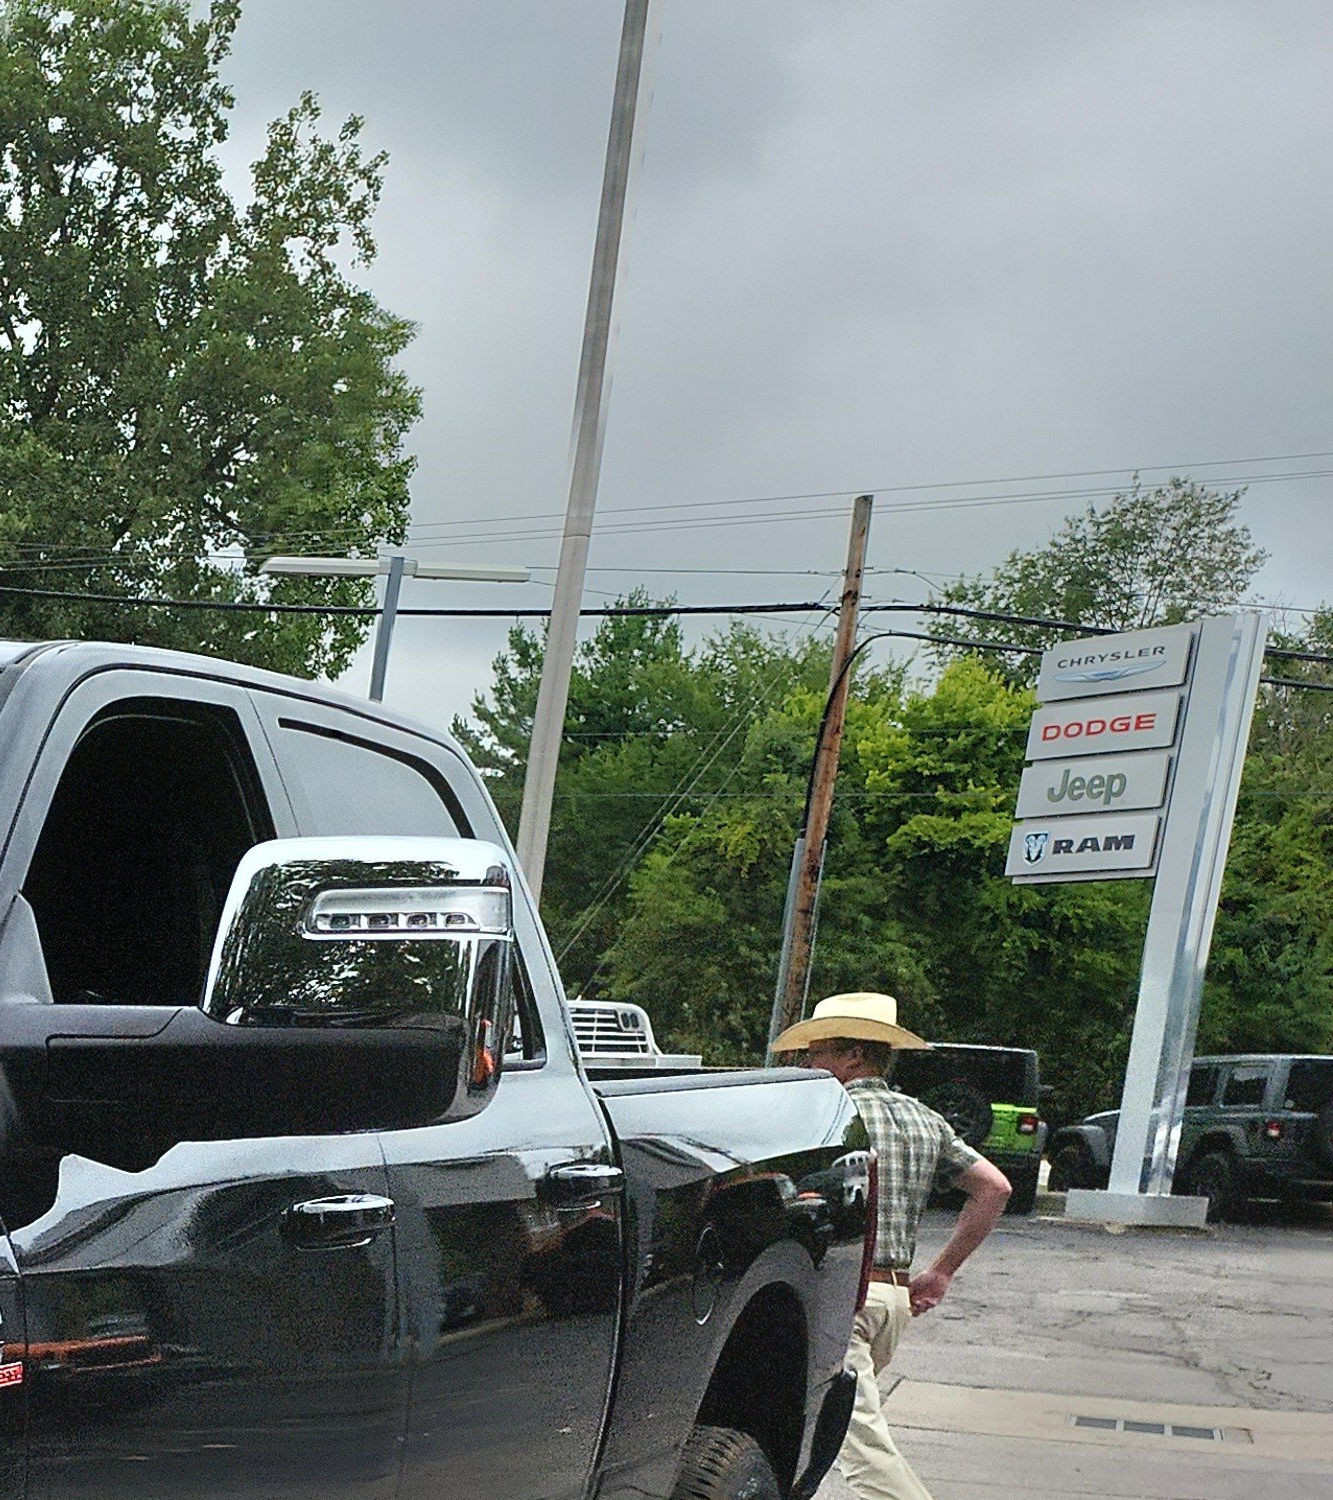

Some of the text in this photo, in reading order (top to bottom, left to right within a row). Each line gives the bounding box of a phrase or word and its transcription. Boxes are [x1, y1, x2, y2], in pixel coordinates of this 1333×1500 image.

[1056, 645, 1166, 669] CHRYSLER
[1041, 712, 1157, 742] DODGE
[1046, 768, 1127, 805] Jeep
[1051, 833, 1136, 856] RAM
